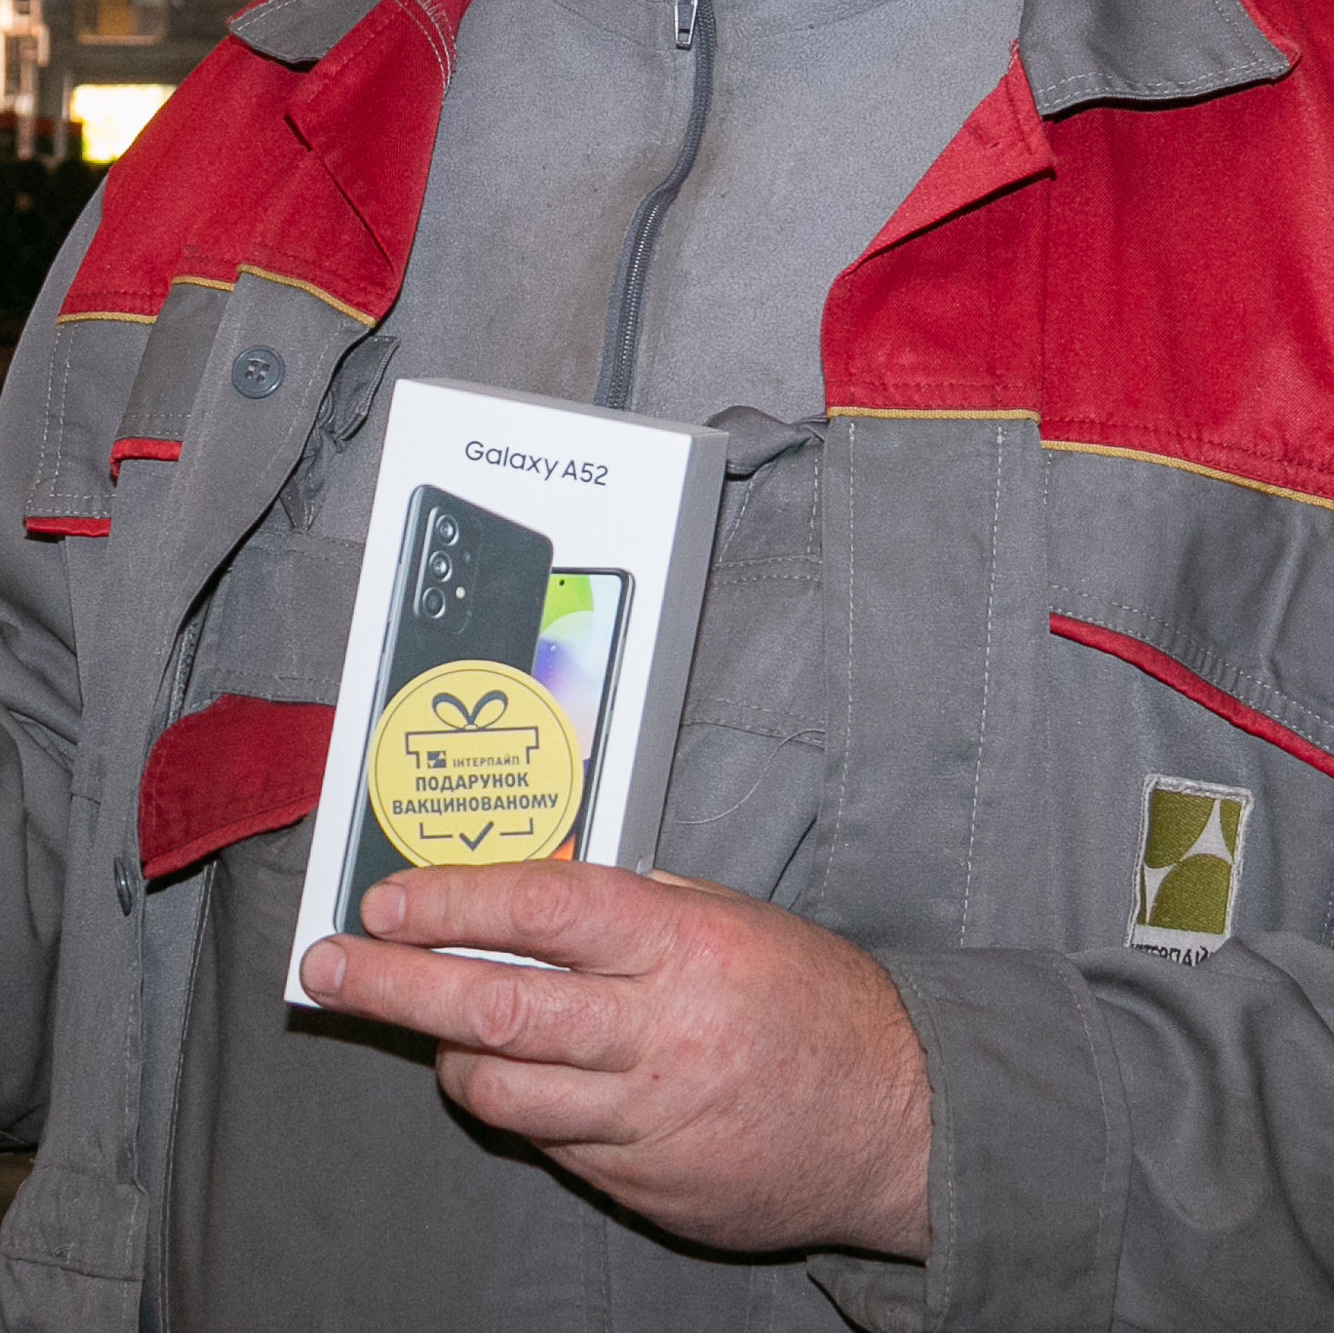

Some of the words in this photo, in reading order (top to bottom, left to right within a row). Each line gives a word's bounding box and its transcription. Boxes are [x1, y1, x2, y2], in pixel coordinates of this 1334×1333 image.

[465, 440, 559, 481] Galaxy
[561, 459, 609, 486] A52
[452, 753, 520, 768] ІНТЕРПАЙП
[415, 772, 530, 793] ПОДАРУНОК
[392, 793, 559, 816] ВАКЦИНОВАНОМУ
